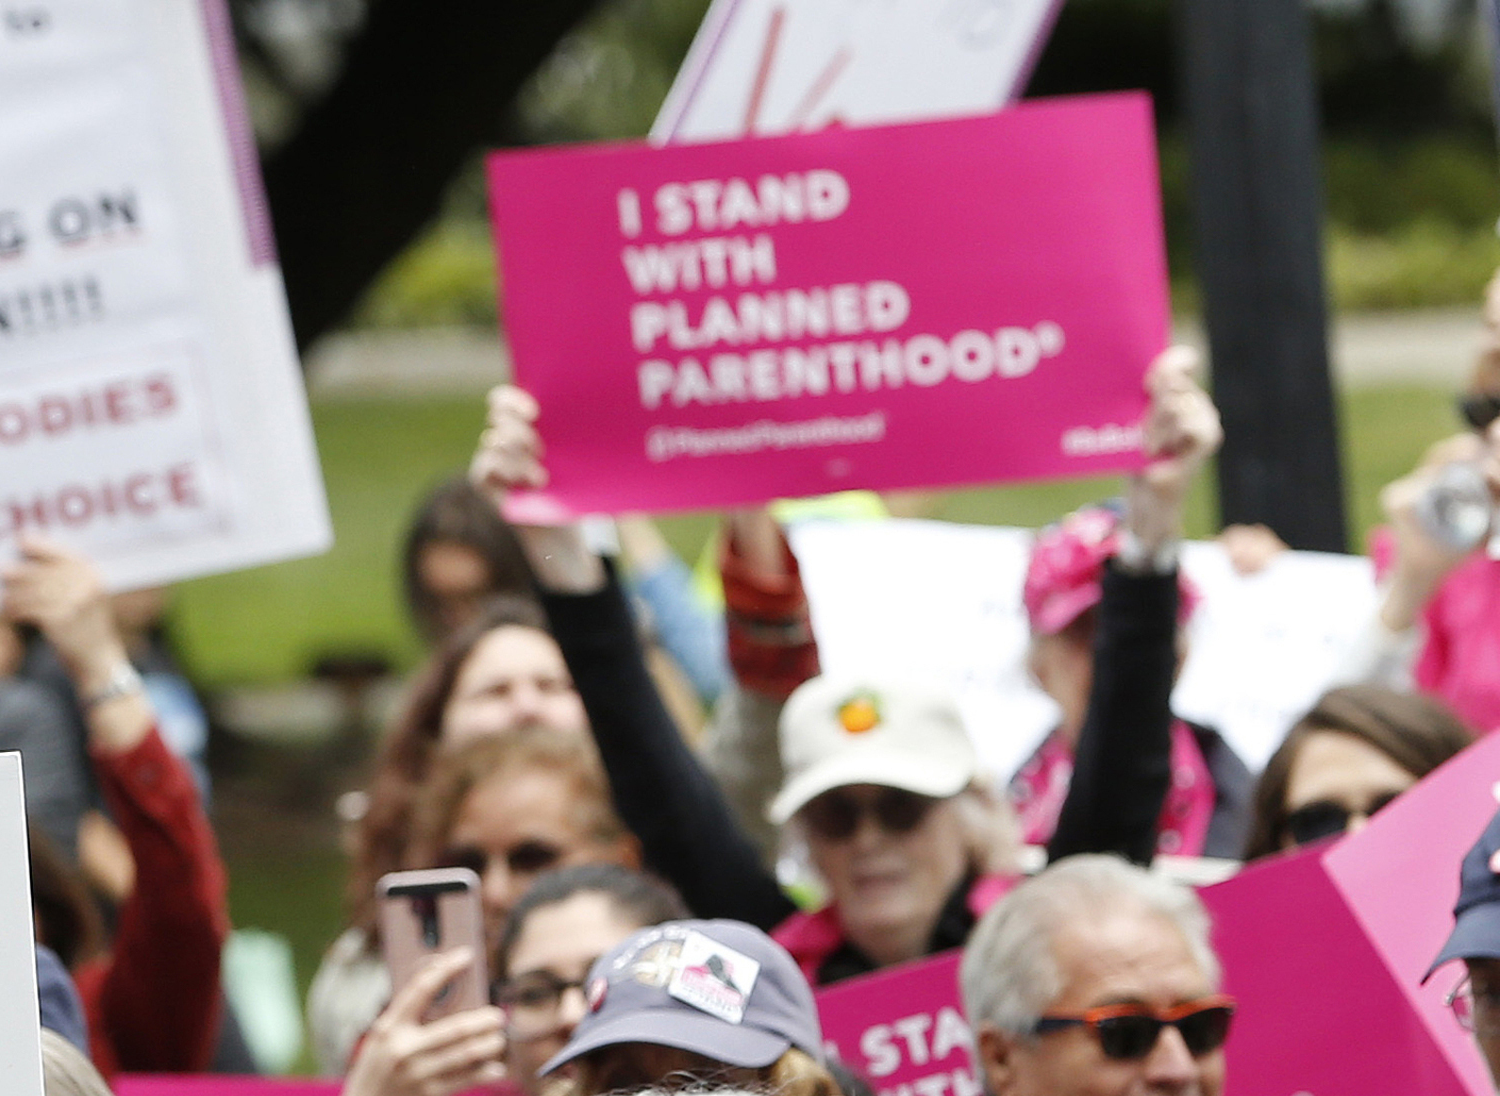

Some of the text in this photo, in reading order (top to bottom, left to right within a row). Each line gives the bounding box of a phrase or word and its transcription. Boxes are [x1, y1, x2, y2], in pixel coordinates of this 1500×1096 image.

[48, 190, 142, 246] ON
[618, 168, 850, 238] I STAND
[622, 233, 776, 293] WITH
[629, 280, 911, 353] PLANNED
[860, 1005, 974, 1077] STA
